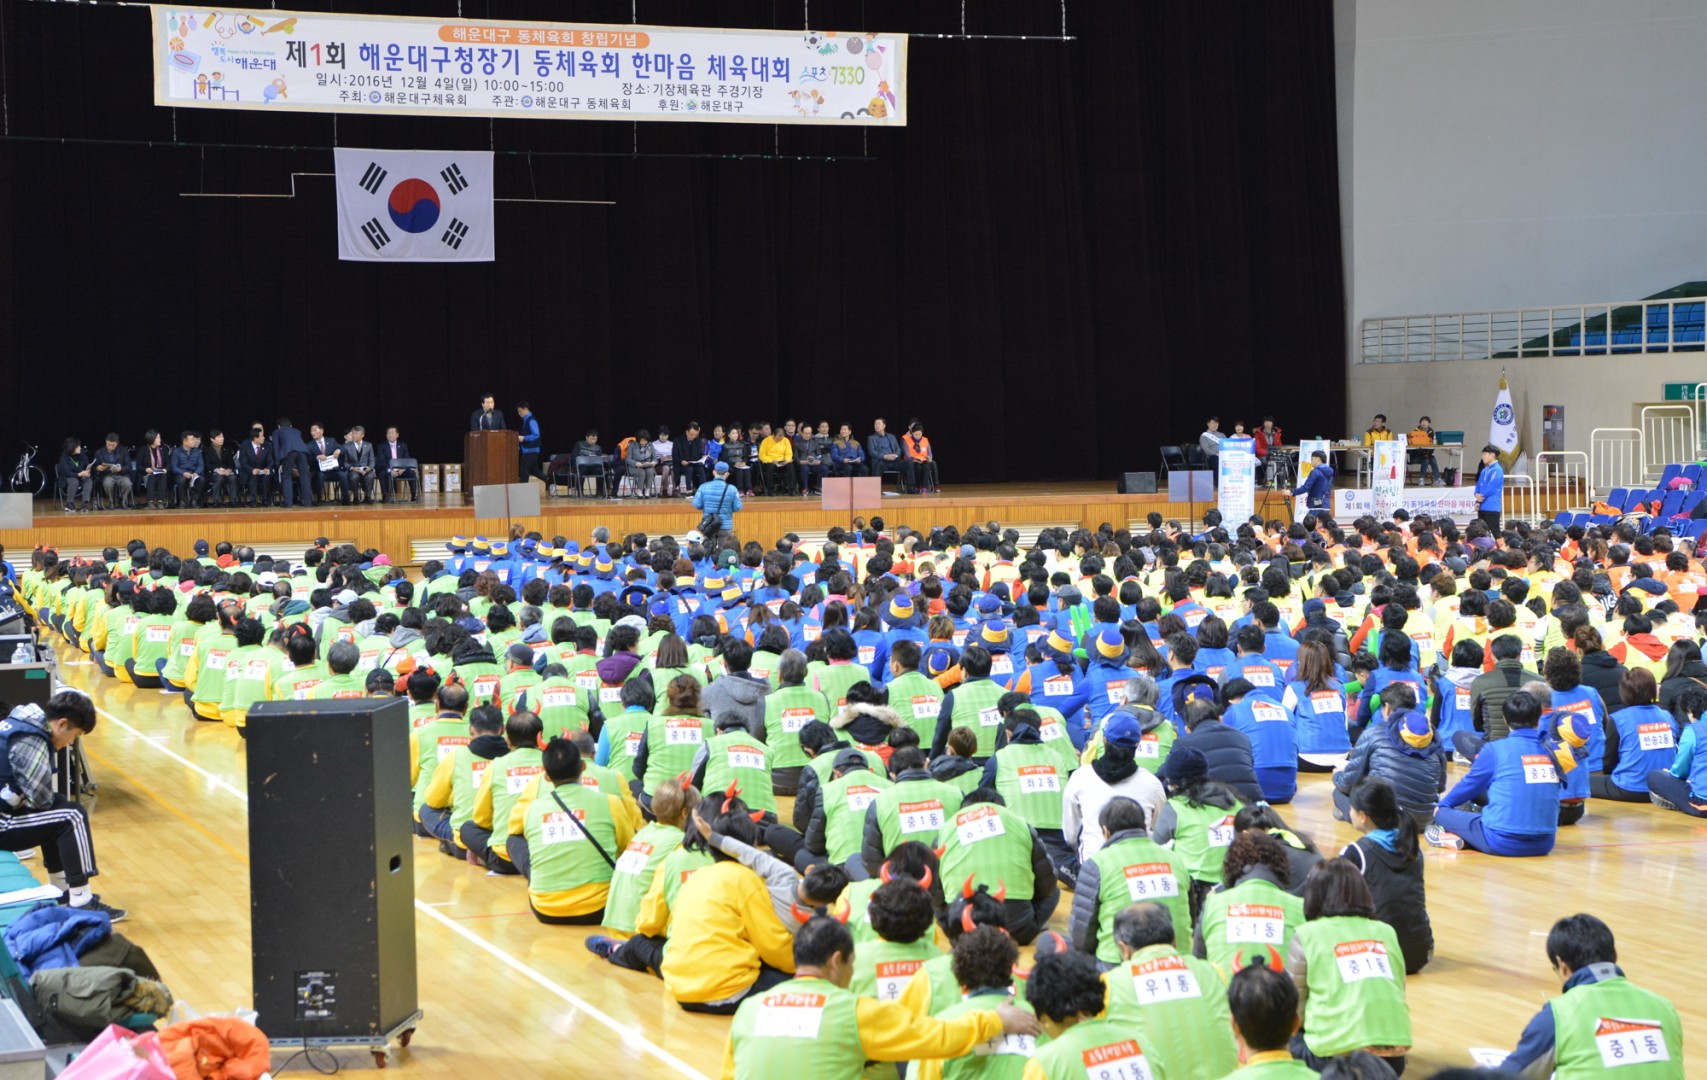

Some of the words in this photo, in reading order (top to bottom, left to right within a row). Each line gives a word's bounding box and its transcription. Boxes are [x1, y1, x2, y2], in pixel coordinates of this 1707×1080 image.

[452, 27, 511, 42] 해운대구
[517, 29, 575, 44] 동체육회
[581, 31, 638, 47] 창립기념
[235, 57, 277, 71] 해운대
[285, 40, 347, 70] 제1회
[359, 42, 519, 76] 해운대구청장기
[533, 49, 620, 78] 동체육회
[631, 51, 696, 81] 한마음
[707, 54, 791, 83] 체육대회
[801, 66, 827, 77] 스포츠
[831, 66, 865, 85] 7330
[400, 75, 427, 90] 12월
[434, 77, 478, 92] 4일(일)
[484, 79, 565, 93] 10:00~15:00
[717, 85, 763, 99] 주경기장
[339, 91, 367, 104] 주최:
[384, 92, 468, 107] 해운대구체육회
[492, 95, 519, 107] 주관:
[535, 97, 581, 109] 해운대구
[587, 98, 632, 110] 동체육회
[658, 99, 684, 111] 후원:
[701, 101, 744, 113] 해운대구
[1345, 501, 1363, 511] 제1회
[1438, 500, 1457, 509] 한마음
[671, 730, 697, 741] 중1동
[1643, 733, 1669, 746] 반송2동
[735, 755, 760, 766] 중1동
[907, 812, 938, 829] 중1동
[1213, 828, 1233, 842] 좌2
[1136, 877, 1171, 894] 중1동
[1235, 921, 1275, 938] 1동
[1145, 974, 1190, 997] 우1동
[1609, 1035, 1658, 1059] 중1동
